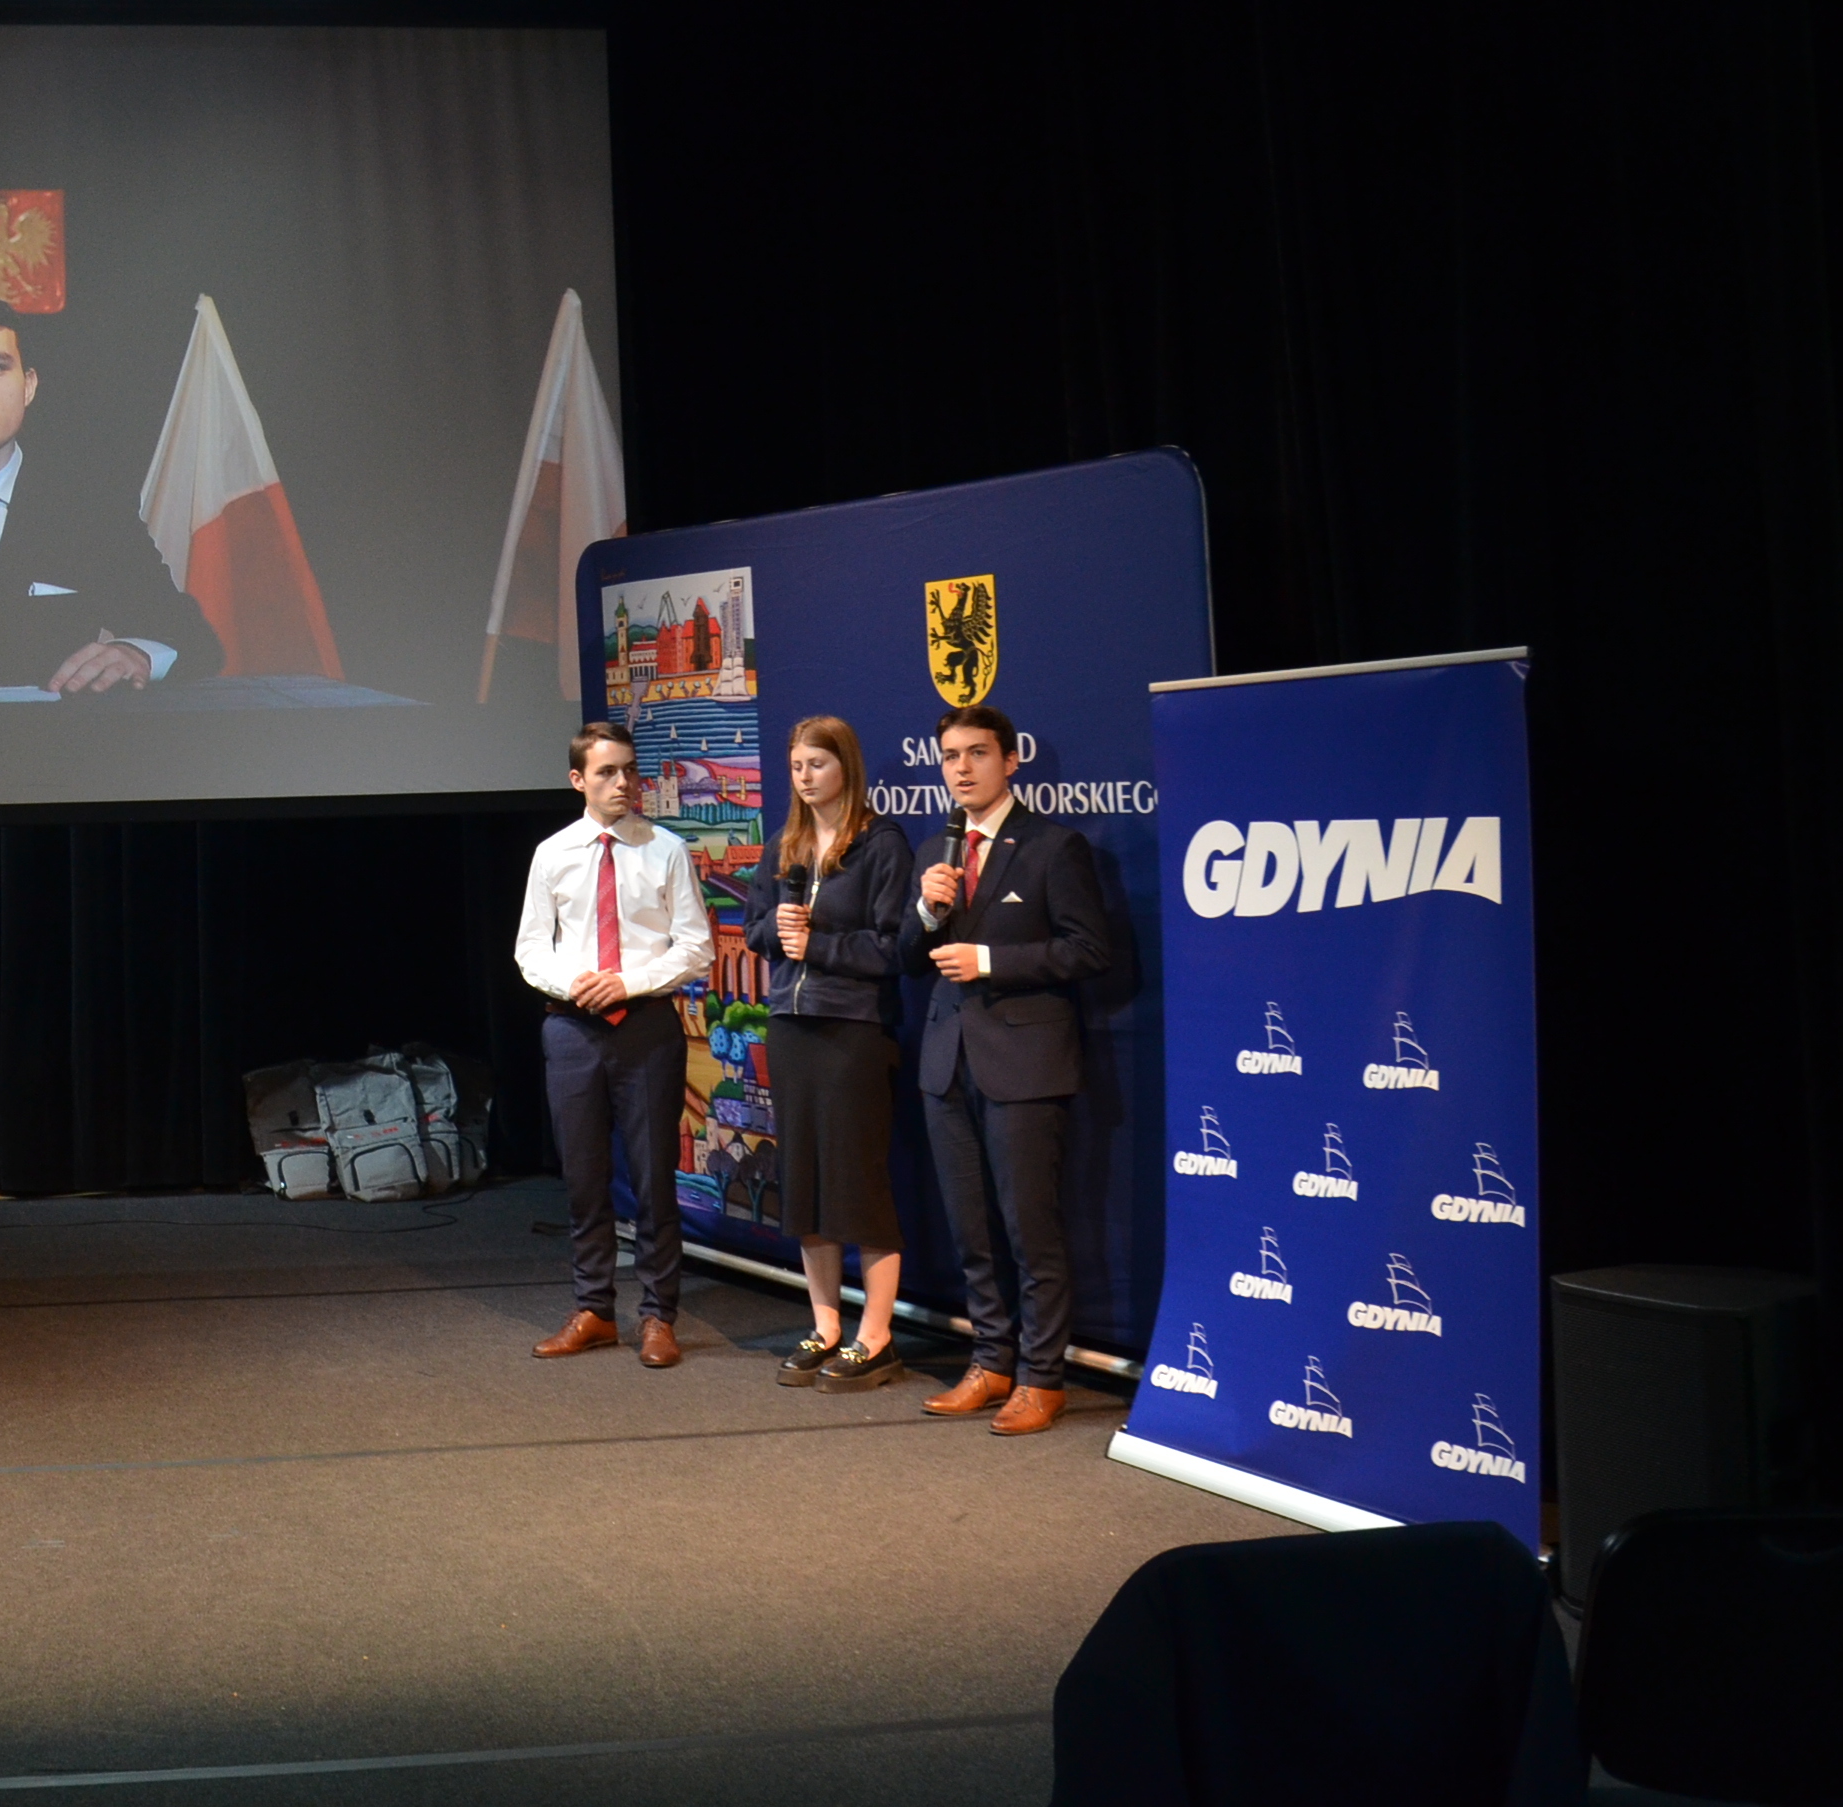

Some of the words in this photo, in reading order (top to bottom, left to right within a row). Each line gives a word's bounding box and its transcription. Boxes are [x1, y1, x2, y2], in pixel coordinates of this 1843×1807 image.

[1009, 780, 1158, 814] MORSKIEG
[1183, 816, 1502, 919] GDYNIA
[1236, 1049, 1302, 1076] GDYNIA
[1363, 1063, 1439, 1091] GDYNIA
[1173, 1151, 1238, 1179] GDYNIA
[1292, 1171, 1358, 1201] GDYNIA
[1431, 1194, 1526, 1227] GDYNIA
[1229, 1271, 1293, 1305] GDYNIA
[1347, 1301, 1442, 1337] GDYNIA
[1150, 1364, 1218, 1399] GDYNIA
[1268, 1400, 1353, 1438] GDYNIA
[1431, 1440, 1526, 1484] GDYNIA
